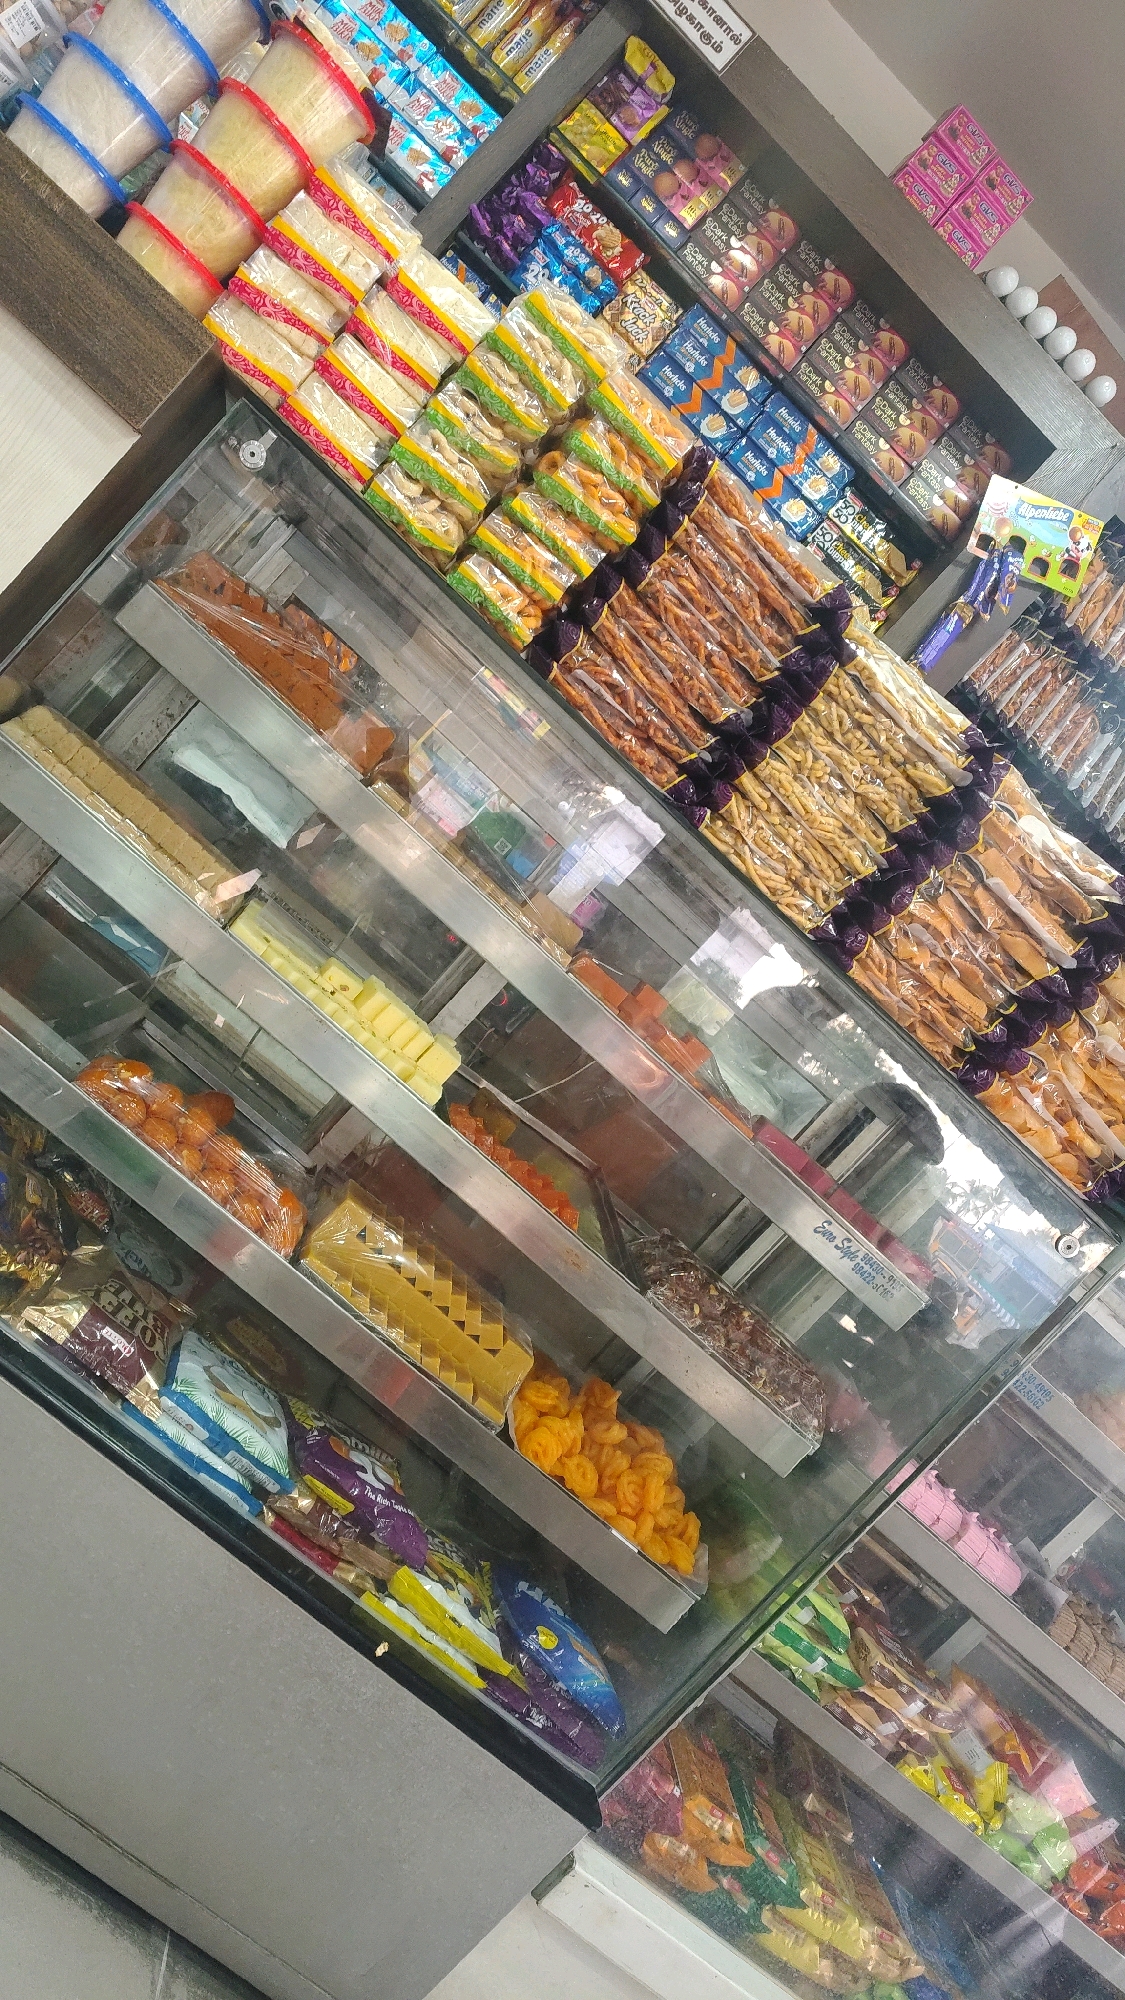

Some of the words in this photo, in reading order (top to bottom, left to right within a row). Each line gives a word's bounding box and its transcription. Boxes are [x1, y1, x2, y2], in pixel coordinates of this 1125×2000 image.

[506, 28, 533, 58] marie
[525, 47, 553, 78] marie
[711, 222, 728, 241] Dark
[718, 208, 744, 238] Fantasy
[728, 208, 744, 228] Dark
[702, 223, 728, 253] Fantasy
[682, 248, 709, 278] Fantasy
[691, 248, 708, 267] Dark
[775, 269, 801, 298] Fantasy
[784, 268, 800, 288] Dark
[759, 283, 786, 313] Fantasy
[768, 283, 785, 302] Dark
[622, 291, 657, 325] Krack
[749, 307, 766, 326] Dark
[621, 316, 649, 343] Jack
[697, 316, 721, 344] Horlicks
[740, 307, 766, 338] Fantasy
[839, 326, 856, 346] Dark
[683, 340, 708, 368] Horlicks
[826, 342, 842, 361] Dark
[831, 327, 856, 356] Fantasy
[817, 343, 843, 374] Fantasy
[662, 364, 687, 391] Horlicks
[797, 367, 823, 397] Fantasy
[805, 367, 822, 387] Dark
[885, 385, 910, 415] Fantasy
[893, 384, 910, 404] Dark
[778, 406, 802, 433] Horlicks
[872, 401, 897, 431] Fantasy
[880, 401, 897, 420] Dark
[852, 426, 877, 455] Fantasy
[860, 425, 877, 444] Dark
[745, 450, 769, 477] Horlicks
[938, 441, 962, 471] Fantasy
[946, 441, 962, 461] Dark
[918, 463, 943, 492] Fantasy
[926, 463, 942, 483] Dark
[906, 482, 932, 511] Fantasy
[914, 481, 931, 501] Dark
[1018, 502, 1071, 522] Alpenliebe
[813, 1220, 837, 1243] Euro
[834, 1238, 859, 1262] Style
